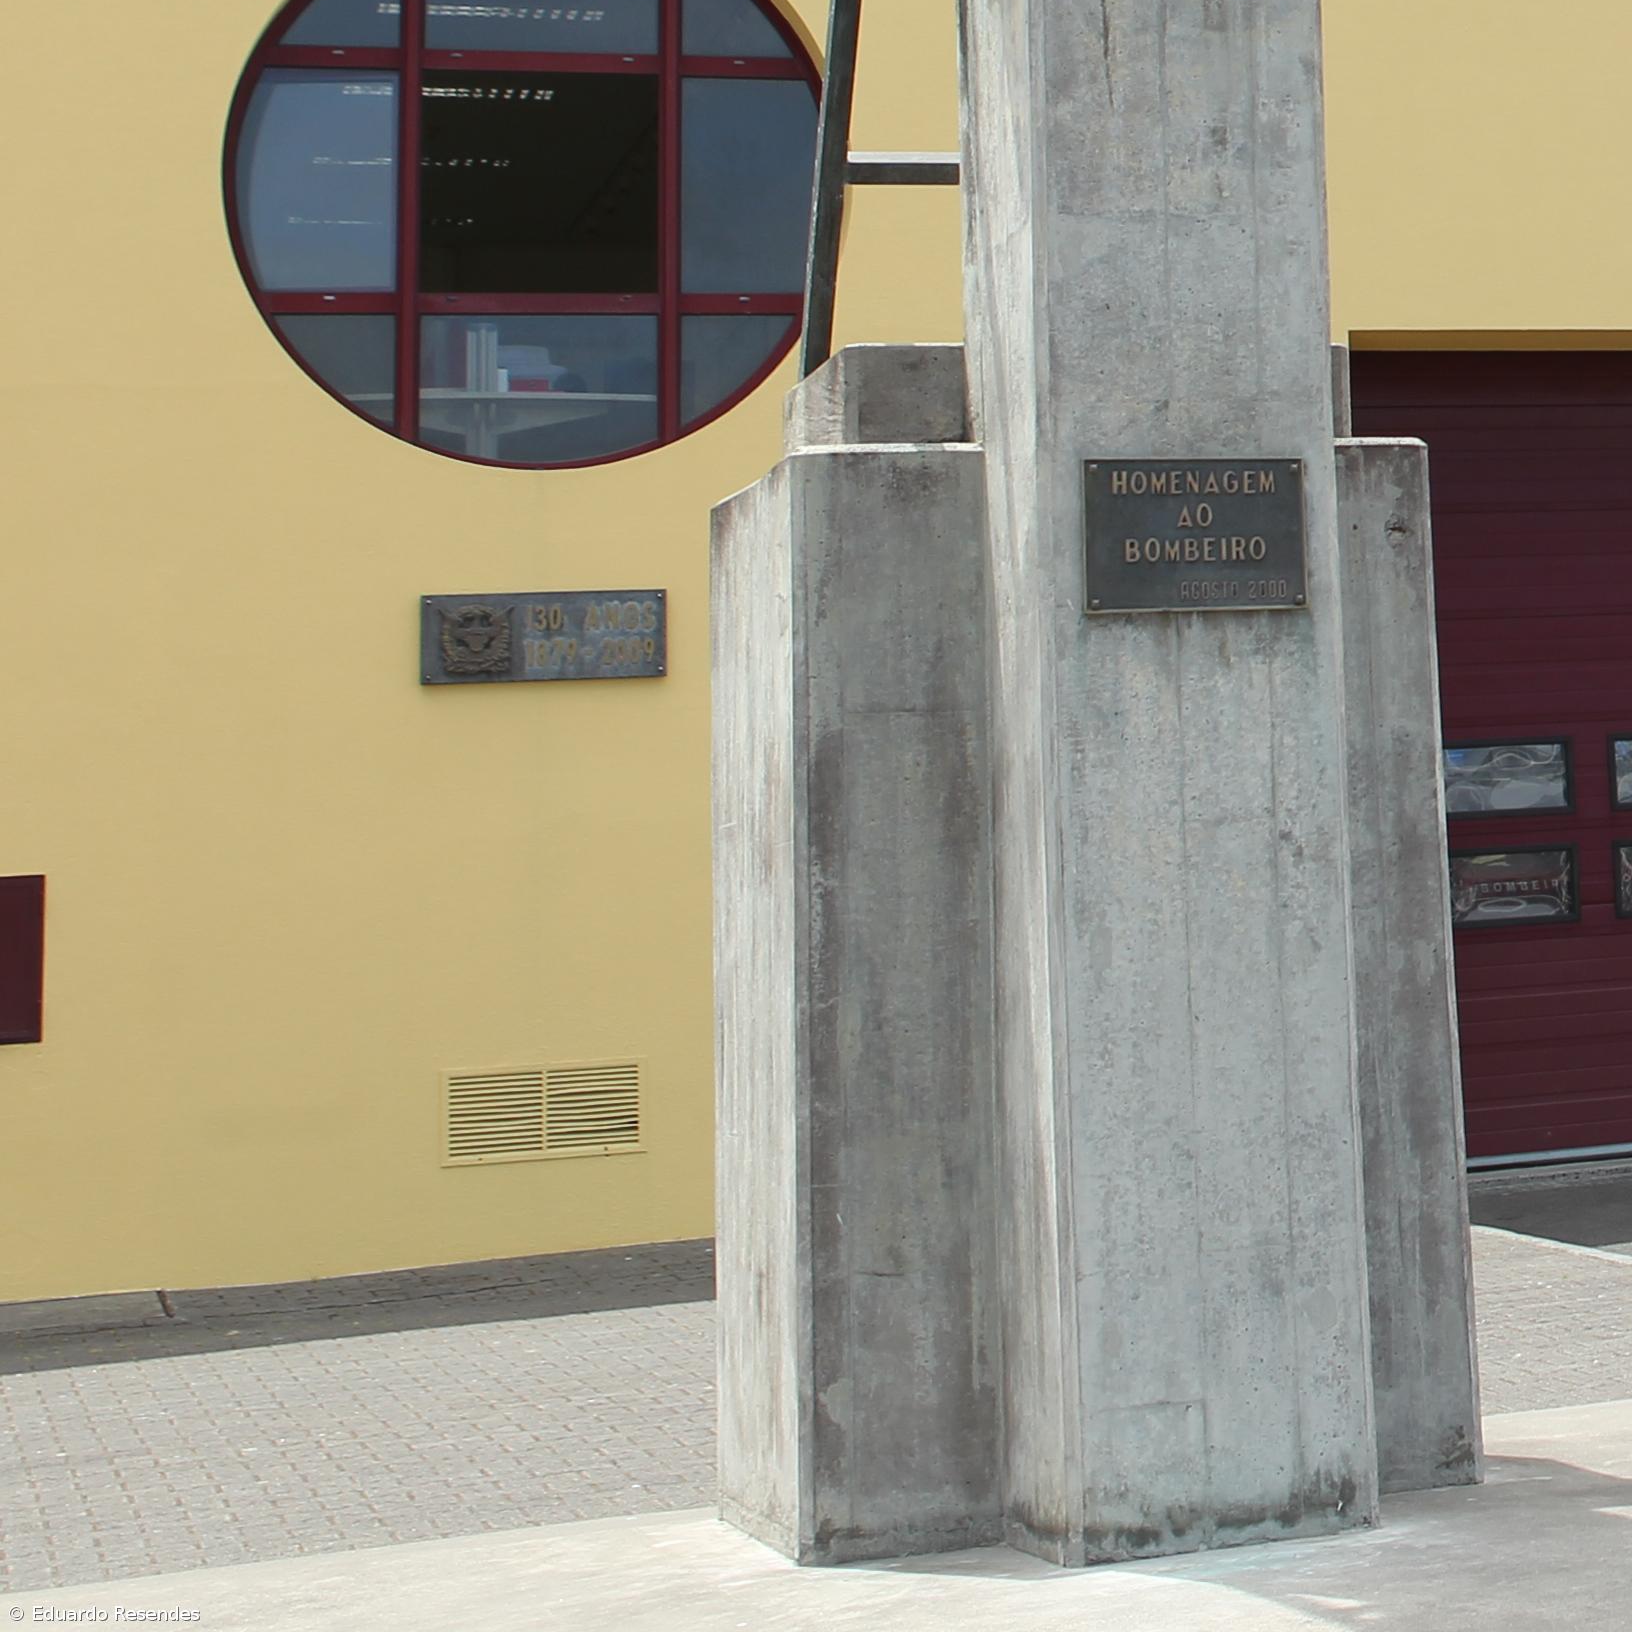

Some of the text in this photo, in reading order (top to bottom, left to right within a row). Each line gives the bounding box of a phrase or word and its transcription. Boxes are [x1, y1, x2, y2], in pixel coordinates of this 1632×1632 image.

[1111, 470, 1276, 495] HOMENAGEM
[1177, 503, 1213, 528] AO
[1125, 536, 1267, 562] BOMBEIRO
[1180, 579, 1287, 600] AGOSTO 2000
[526, 600, 656, 632] 130 ANOS
